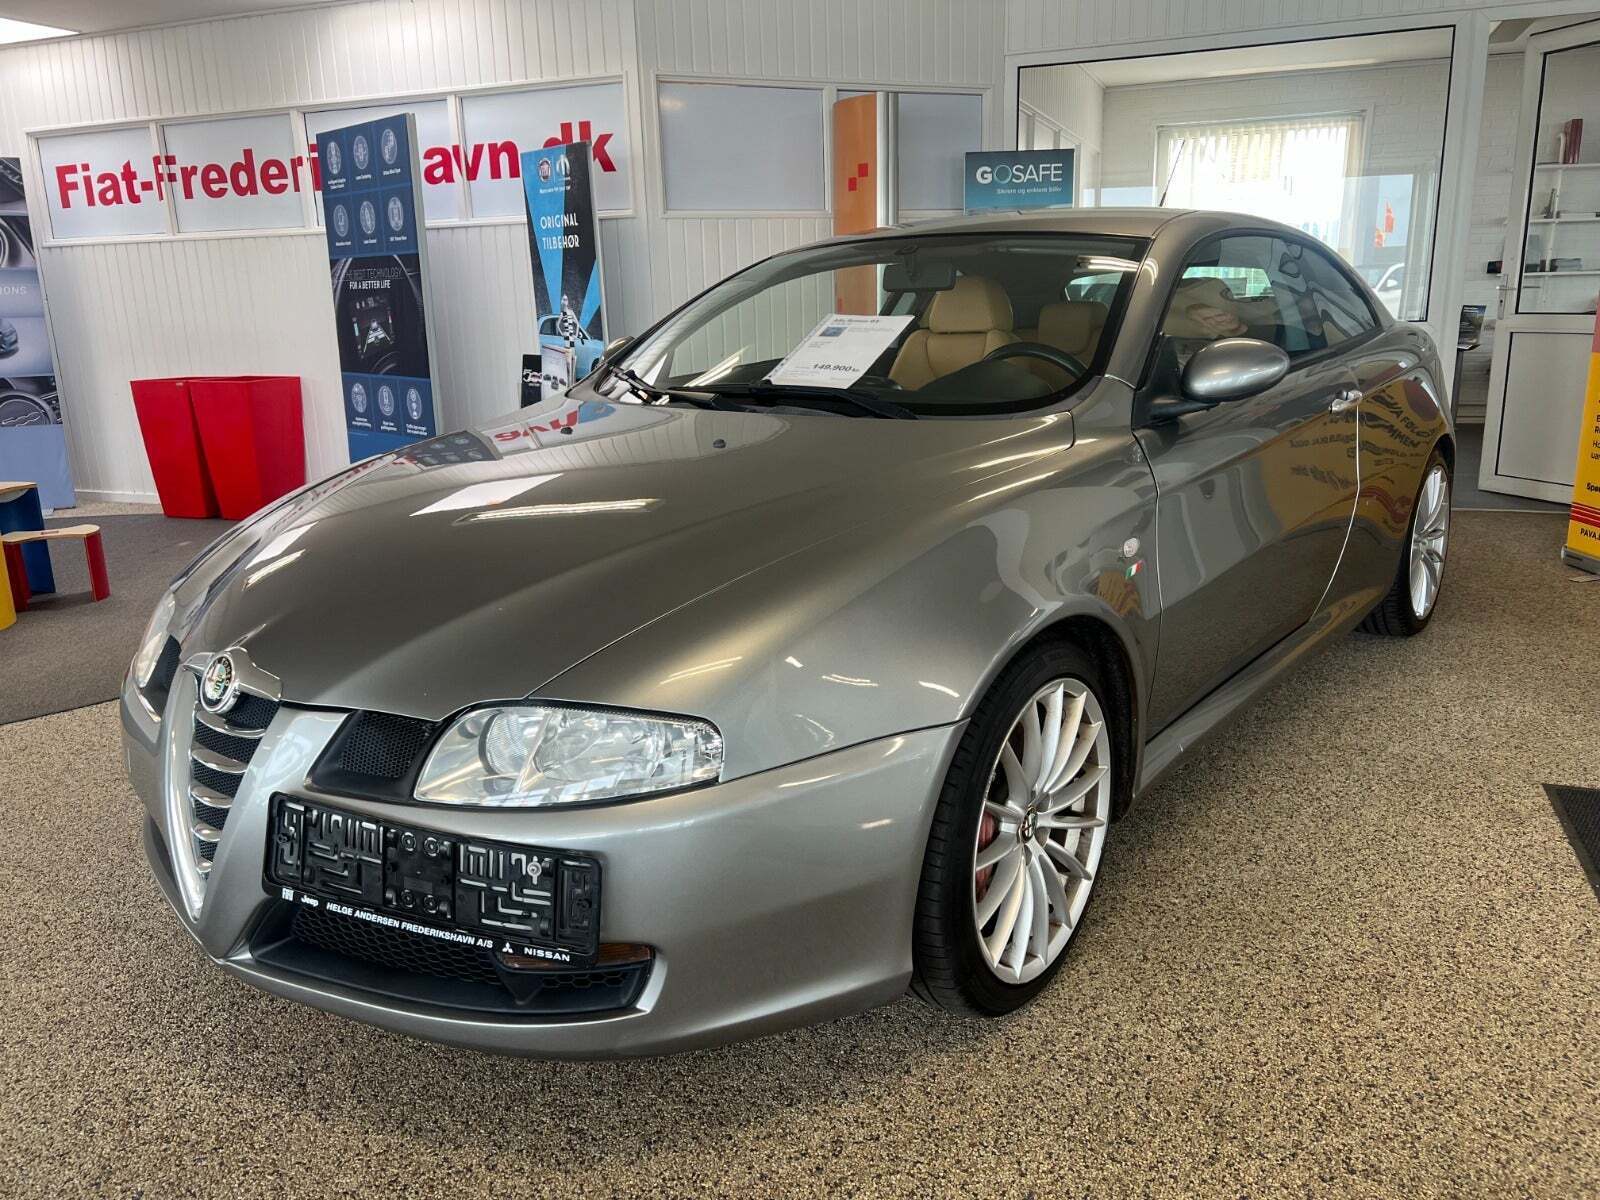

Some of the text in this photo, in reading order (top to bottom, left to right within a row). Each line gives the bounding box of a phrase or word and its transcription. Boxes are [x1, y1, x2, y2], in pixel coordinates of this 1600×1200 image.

[976, 163, 1063, 184] GOSAFE
[540, 213, 578, 229] ORIGINAL
[542, 234, 580, 249] TILBEHØR
[363, 281, 380, 289] BETTER
[381, 280, 391, 288] LIFE
[813, 362, 853, 372] 149.900
[301, 895, 319, 907] Jeep
[326, 902, 353, 916] HELGE
[354, 910, 400, 929] ANDERSEN
[401, 922, 476, 946] FREDERIKSHAVN
[475, 938, 494, 949] A/S
[524, 946, 570, 961] NISSAN
